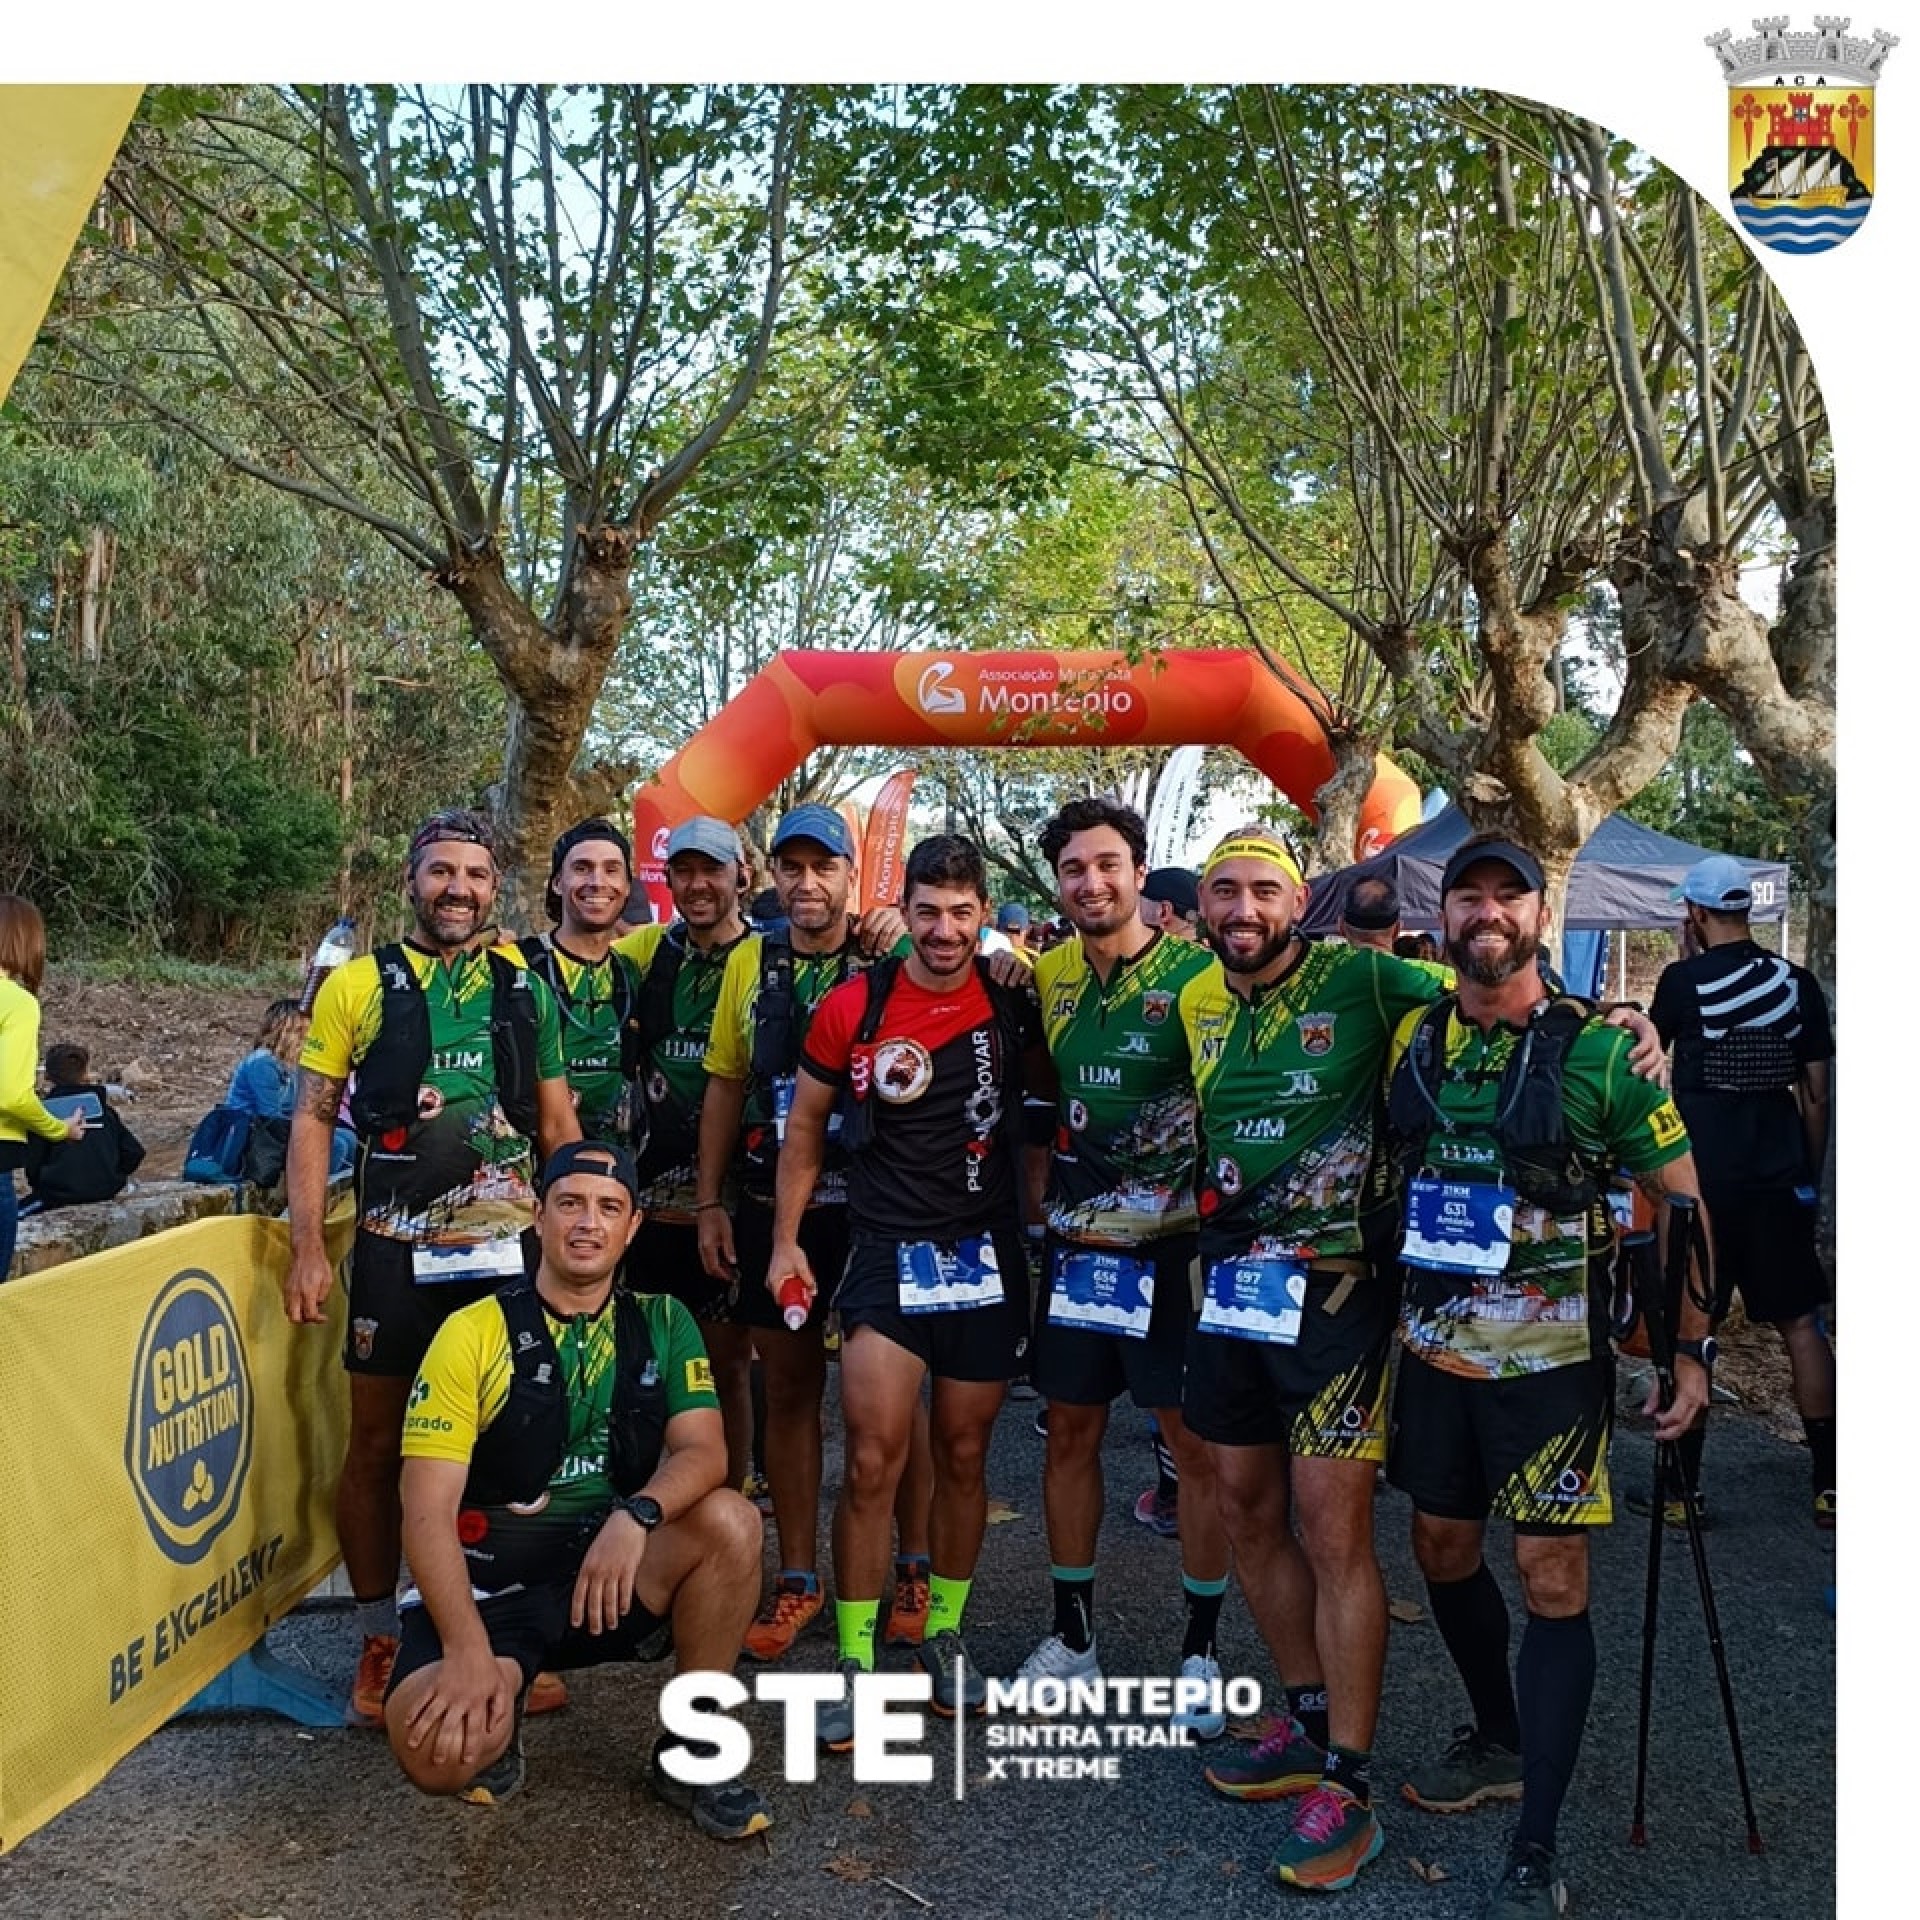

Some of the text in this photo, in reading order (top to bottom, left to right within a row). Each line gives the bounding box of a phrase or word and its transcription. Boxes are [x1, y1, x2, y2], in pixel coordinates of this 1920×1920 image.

[978, 686, 1133, 714] Montepio
[152, 1323, 230, 1414] GOLD
[146, 1382, 239, 1472] NUTRITION
[109, 1533, 283, 1704] BE EXCELLENT
